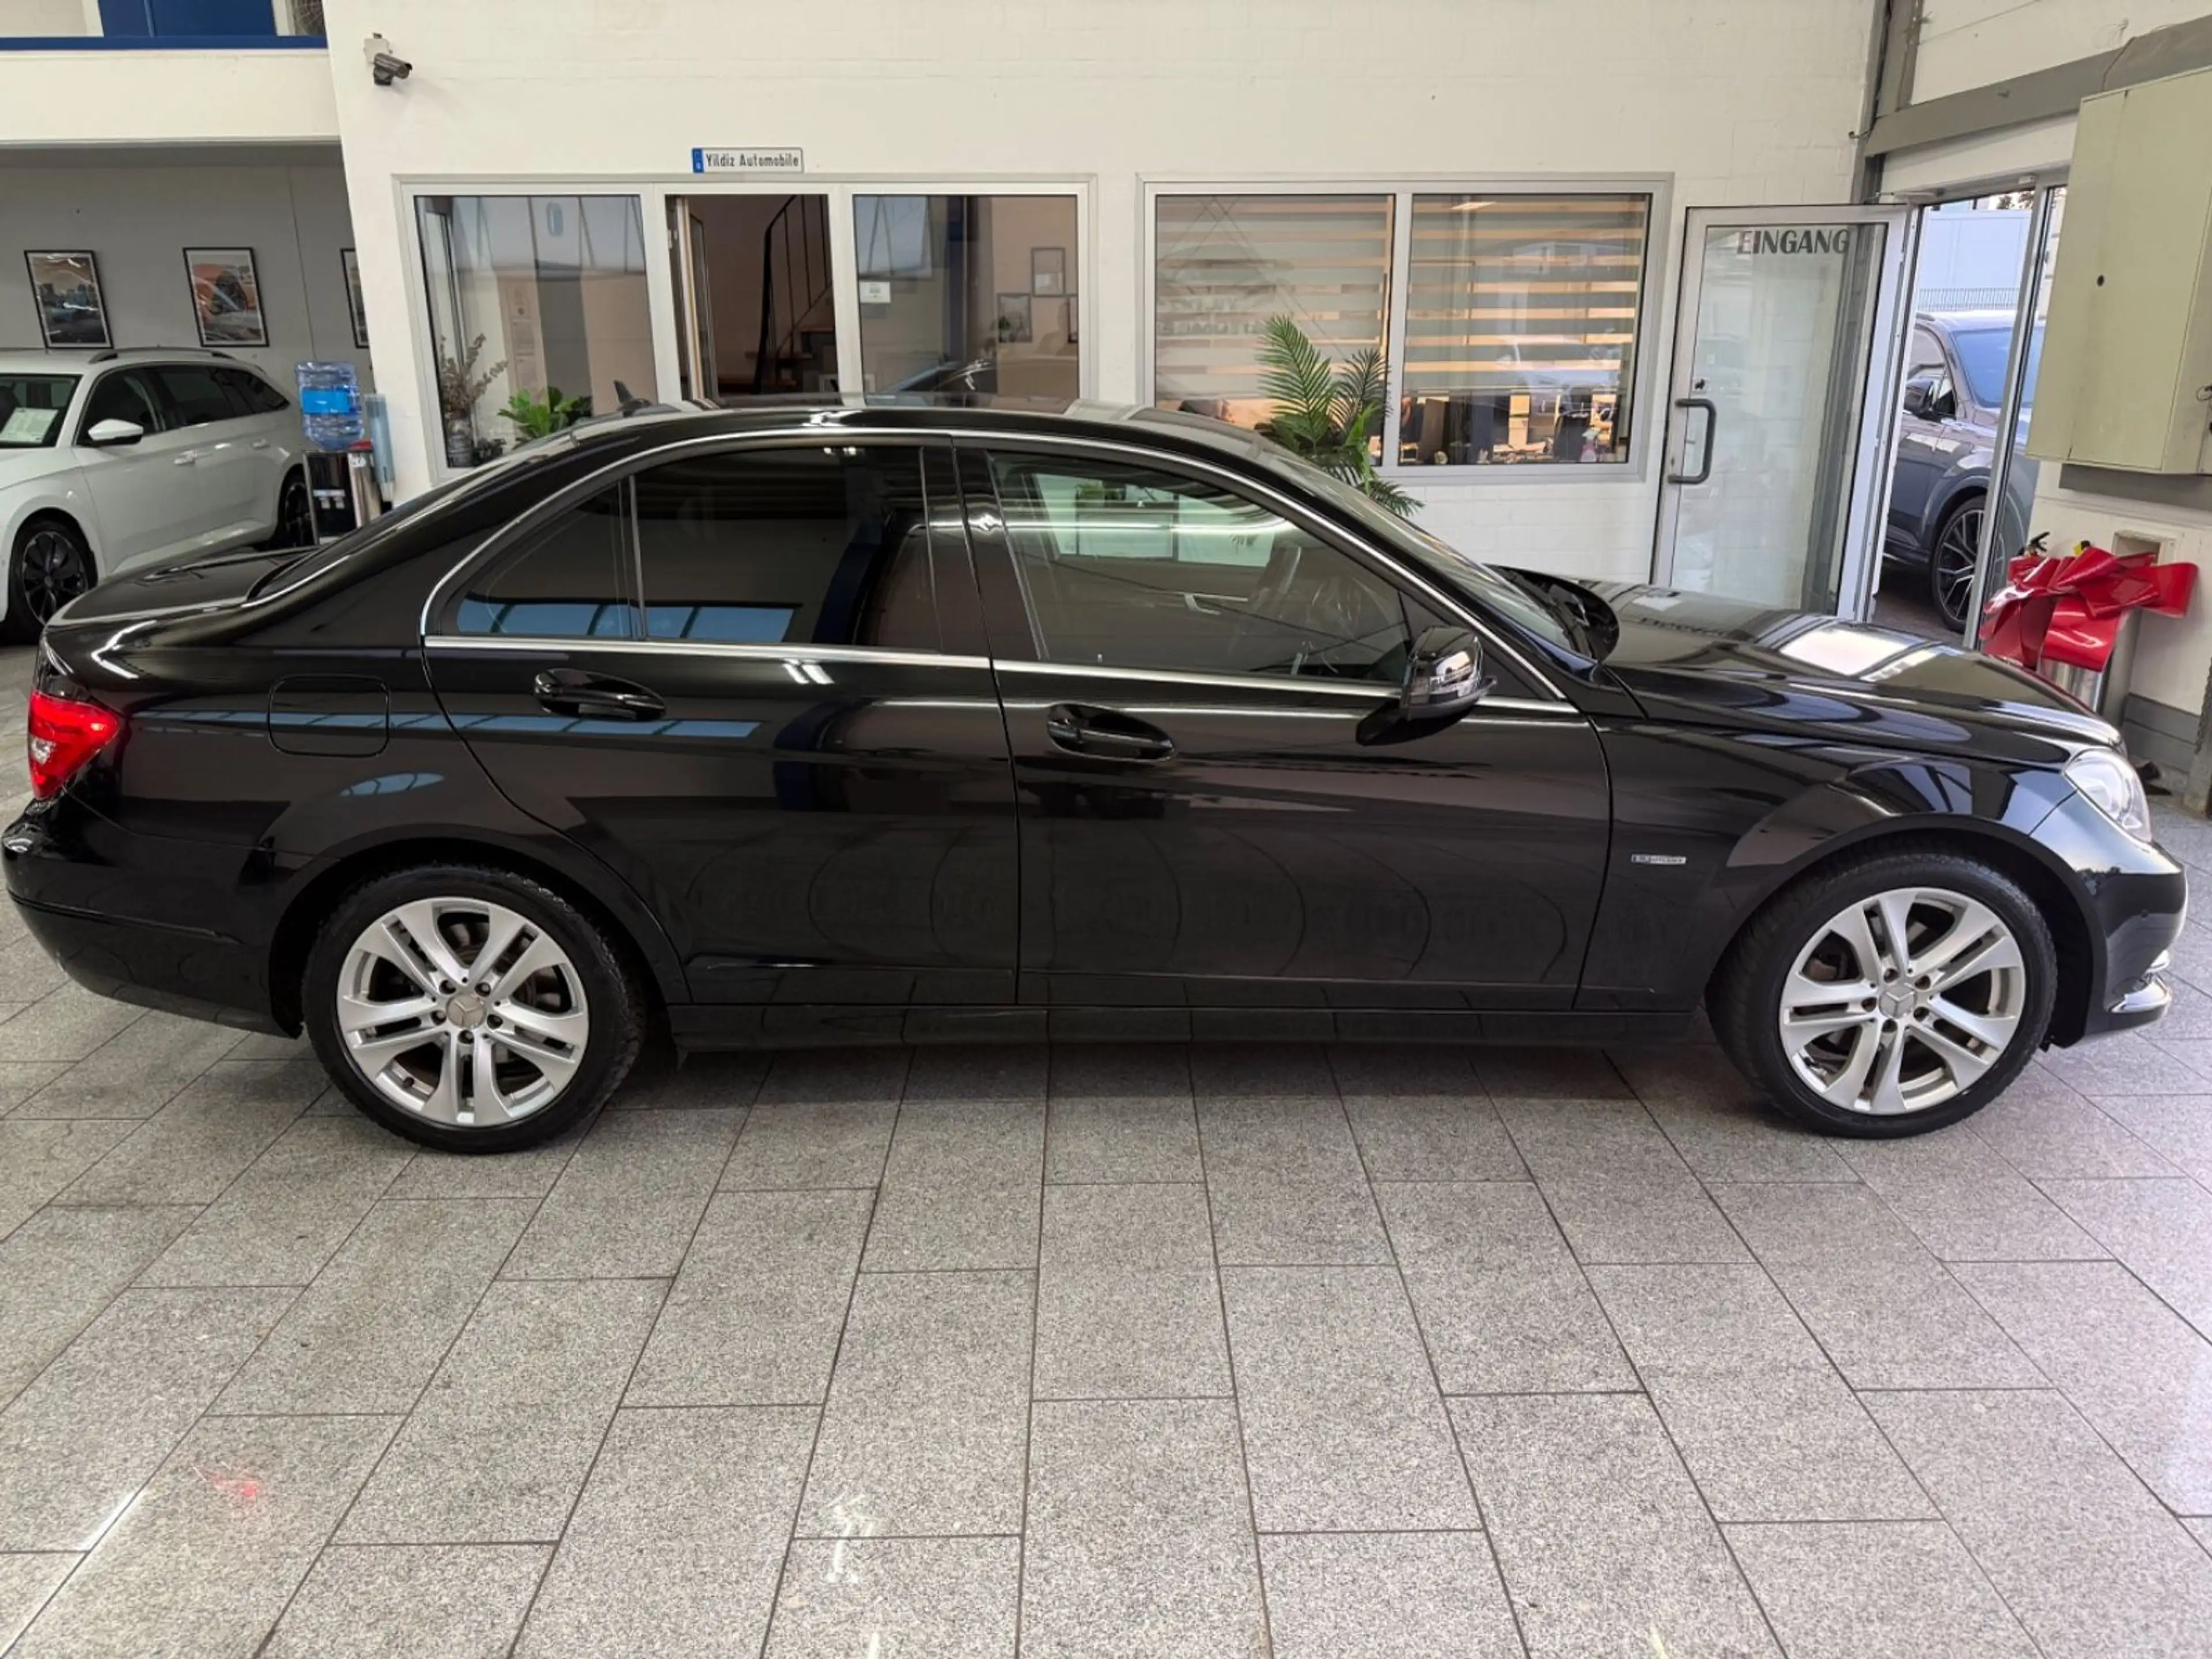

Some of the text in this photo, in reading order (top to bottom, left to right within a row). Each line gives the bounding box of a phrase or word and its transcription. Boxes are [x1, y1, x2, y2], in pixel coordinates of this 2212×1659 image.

[706, 153, 734, 166] Yildiz
[739, 153, 799, 166] Automobile
[1737, 229, 1849, 255] EINGANG
